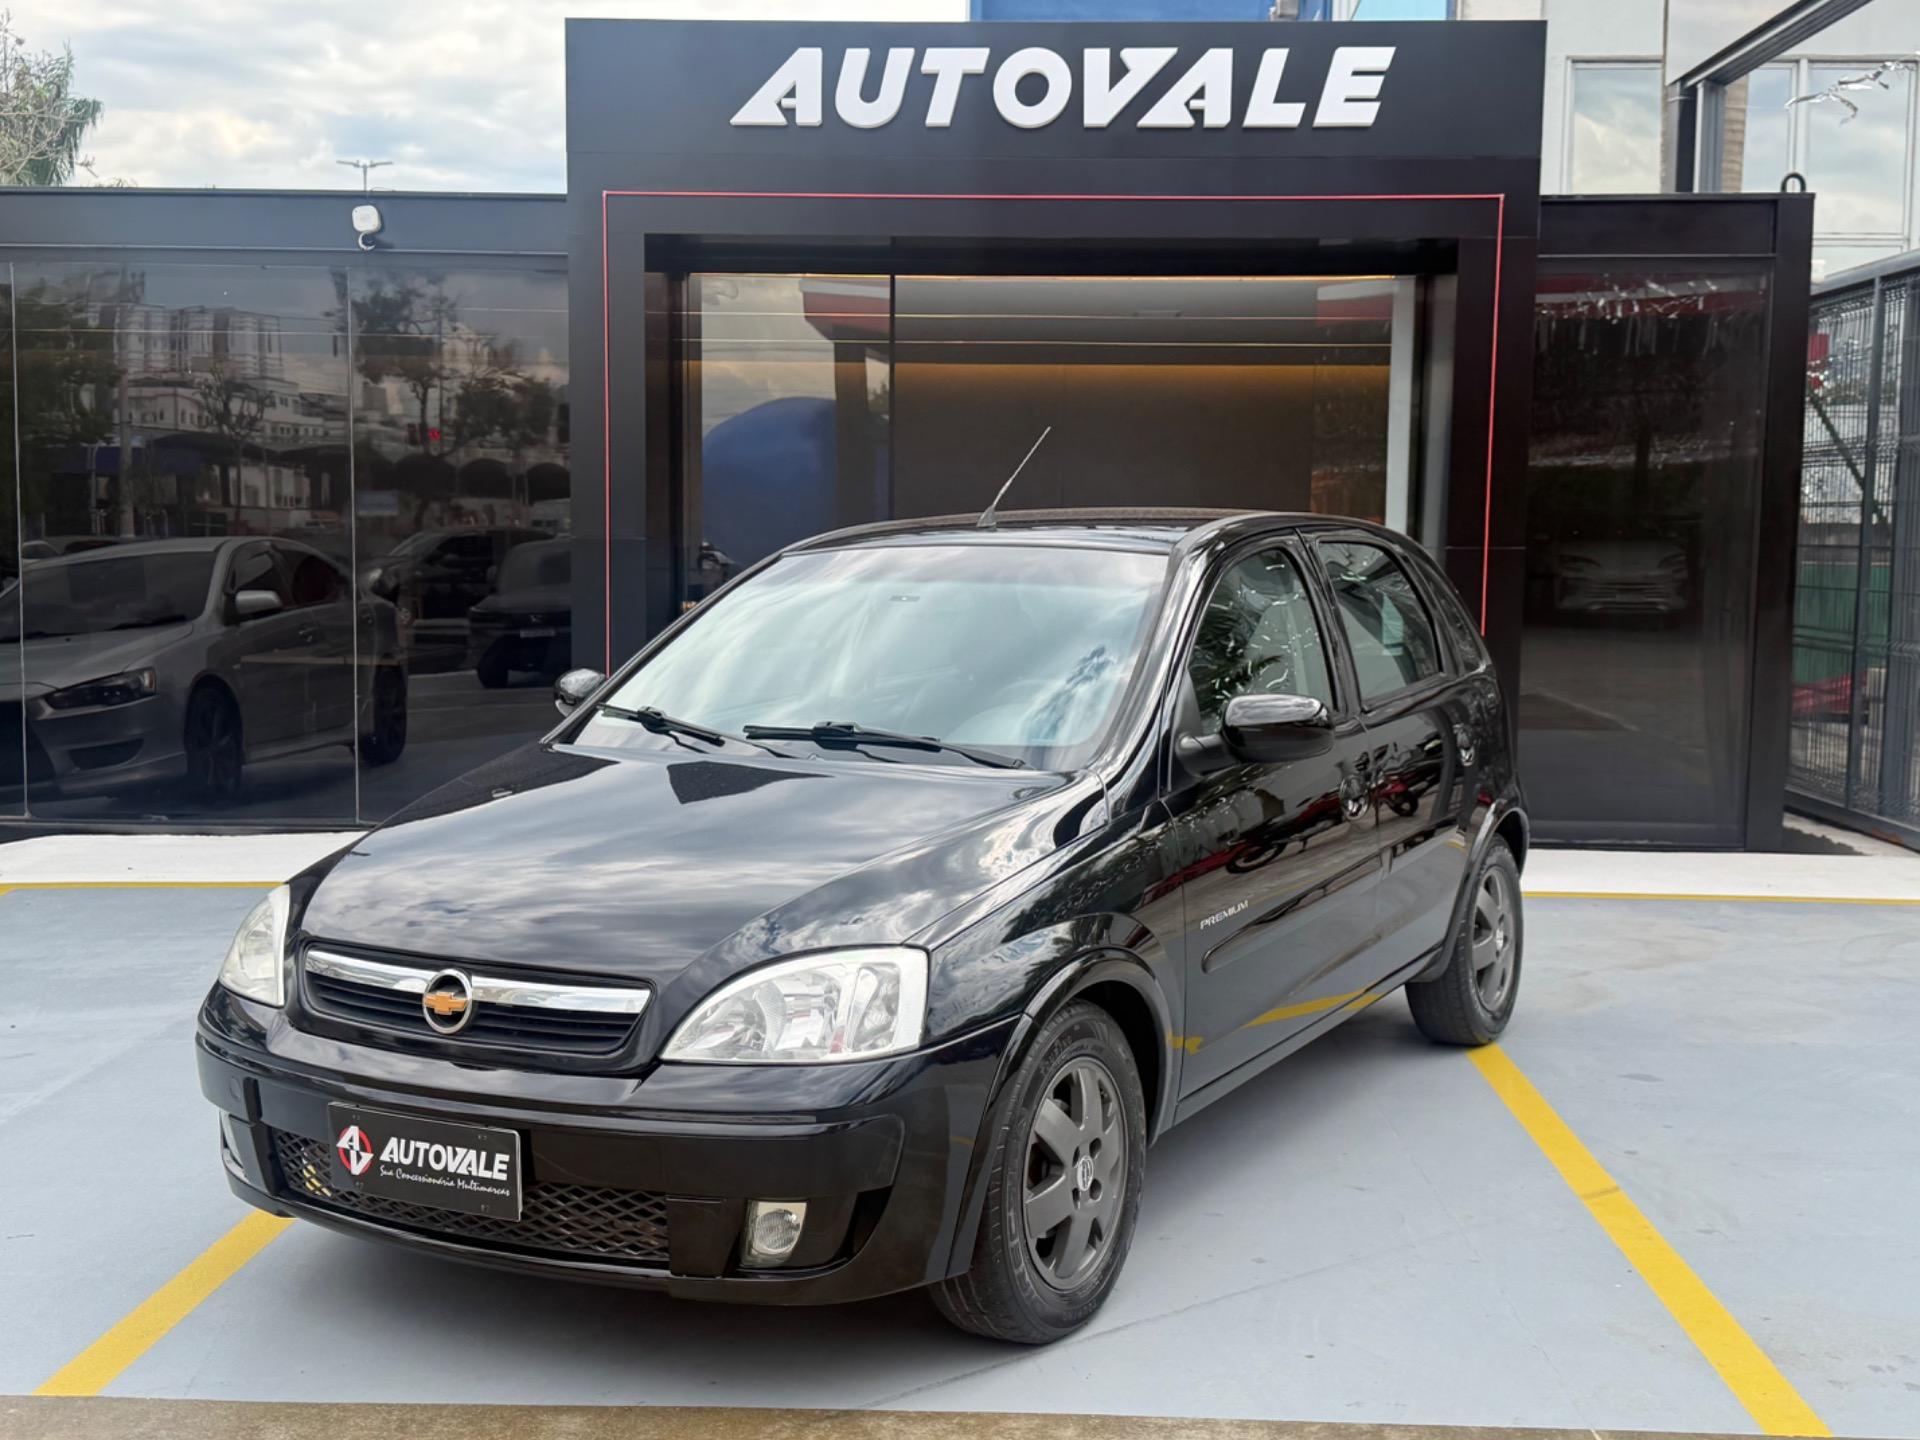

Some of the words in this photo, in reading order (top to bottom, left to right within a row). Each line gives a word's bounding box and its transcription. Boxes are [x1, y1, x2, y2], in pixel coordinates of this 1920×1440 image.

[730, 46, 1397, 128] AUTOVALE
[1200, 900, 1249, 930] PREMIUM
[379, 1137, 510, 1181] AUTOVALE
[457, 1178, 510, 1196] Multimarcas
